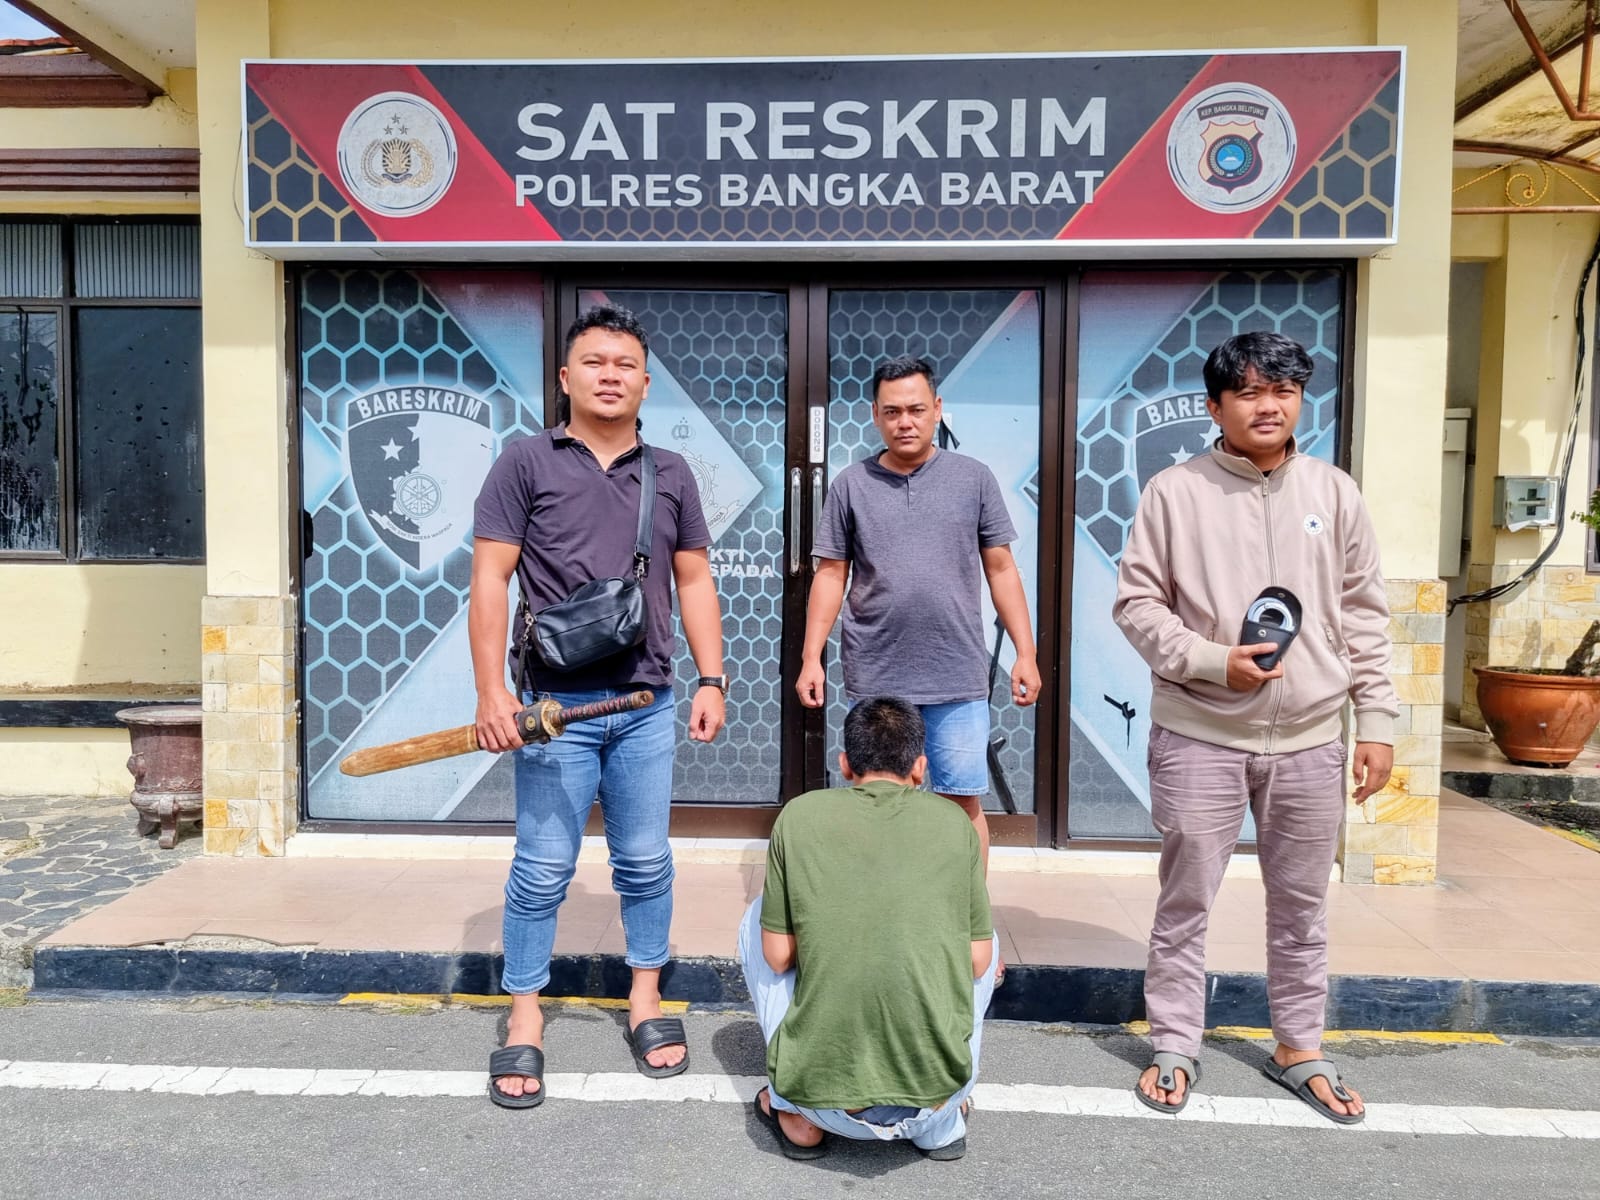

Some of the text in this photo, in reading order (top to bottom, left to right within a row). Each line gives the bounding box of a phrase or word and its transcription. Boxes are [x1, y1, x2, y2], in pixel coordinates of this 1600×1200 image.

[1213, 105, 1237, 114] BANGKA
[1237, 105, 1265, 116] BELITUNG
[515, 97, 1107, 161] SAT RESKRIM
[515, 170, 1104, 207] POLRES BANGKA BARAT
[356, 389, 482, 420] BARESKRIM
[1146, 395, 1206, 426] BARE
[709, 548, 745, 562] KTI
[709, 563, 775, 578] SPADA
